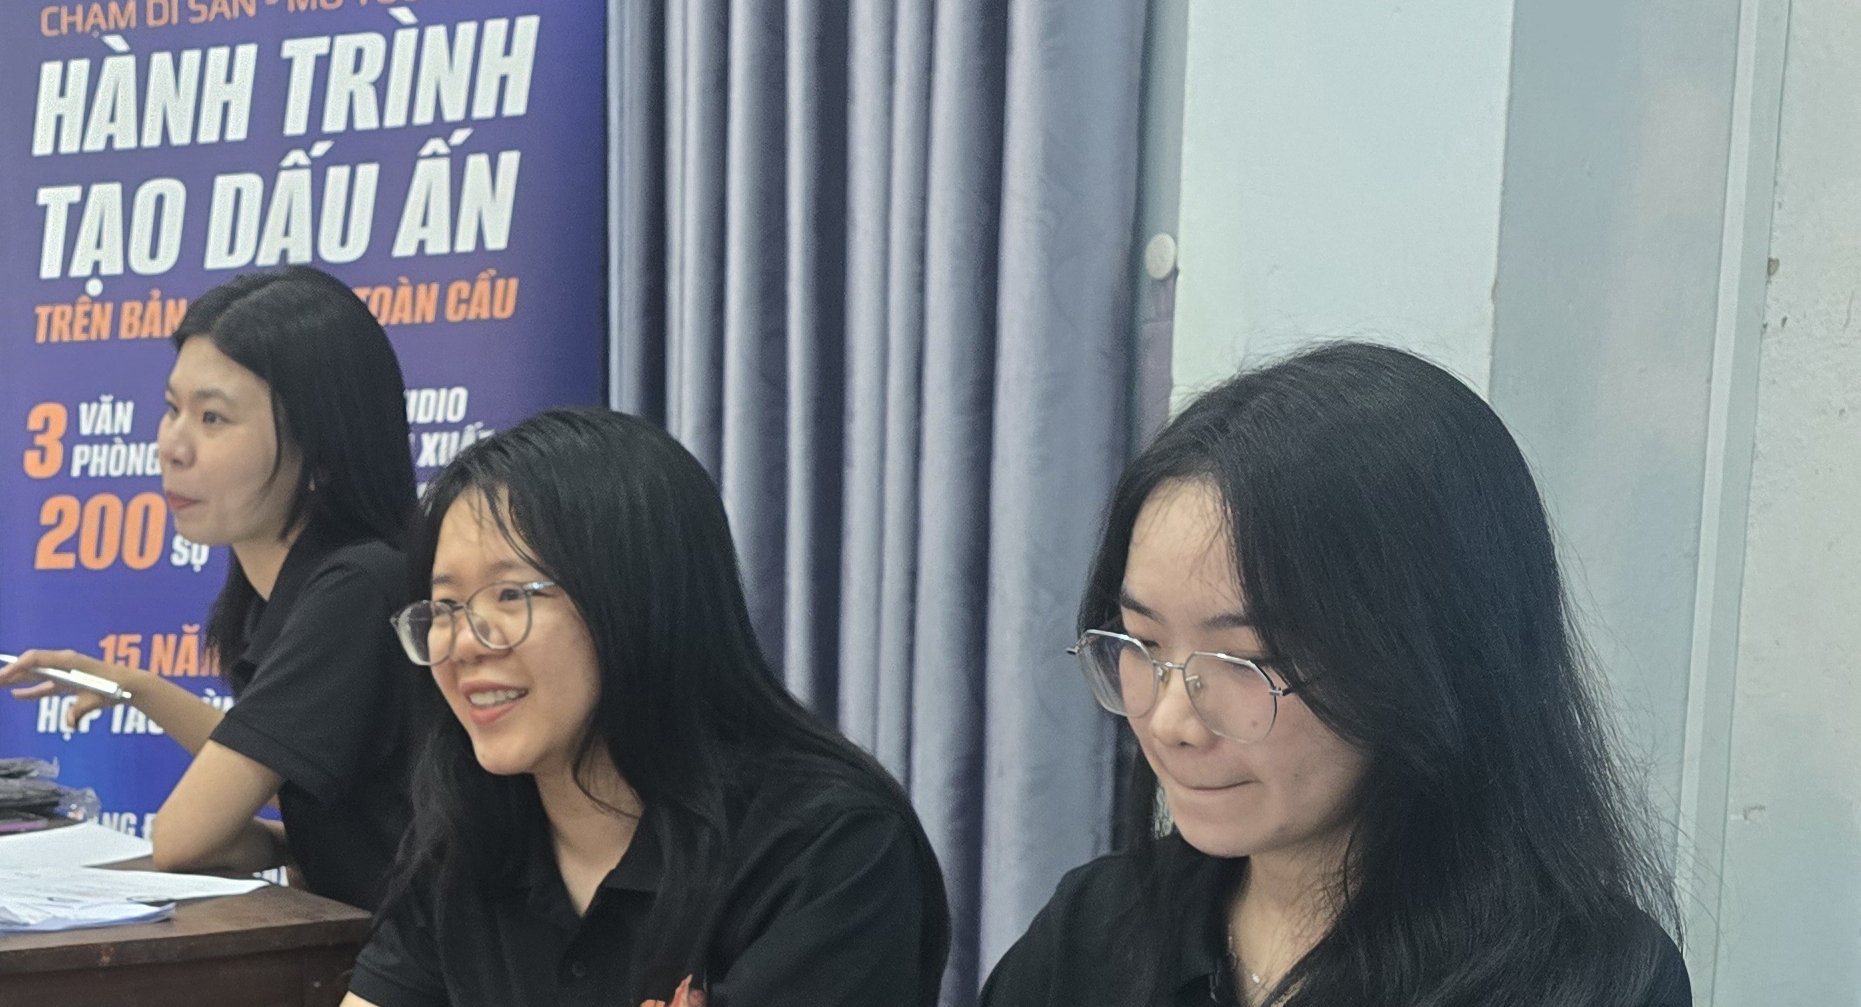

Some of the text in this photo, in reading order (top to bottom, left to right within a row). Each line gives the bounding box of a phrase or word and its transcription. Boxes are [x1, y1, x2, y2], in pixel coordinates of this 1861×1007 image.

[32, 7, 540, 157] HÀNH TRÌNH
[36, 128, 521, 297] TẠO DẤU ẤN
[34, 294, 114, 344] TRÊN
[118, 288, 188, 340] BẢN
[23, 401, 68, 479] 3
[78, 393, 135, 436] VĂN
[70, 436, 162, 478] PHÒNG
[34, 491, 167, 570] 200
[98, 633, 143, 669] 15
